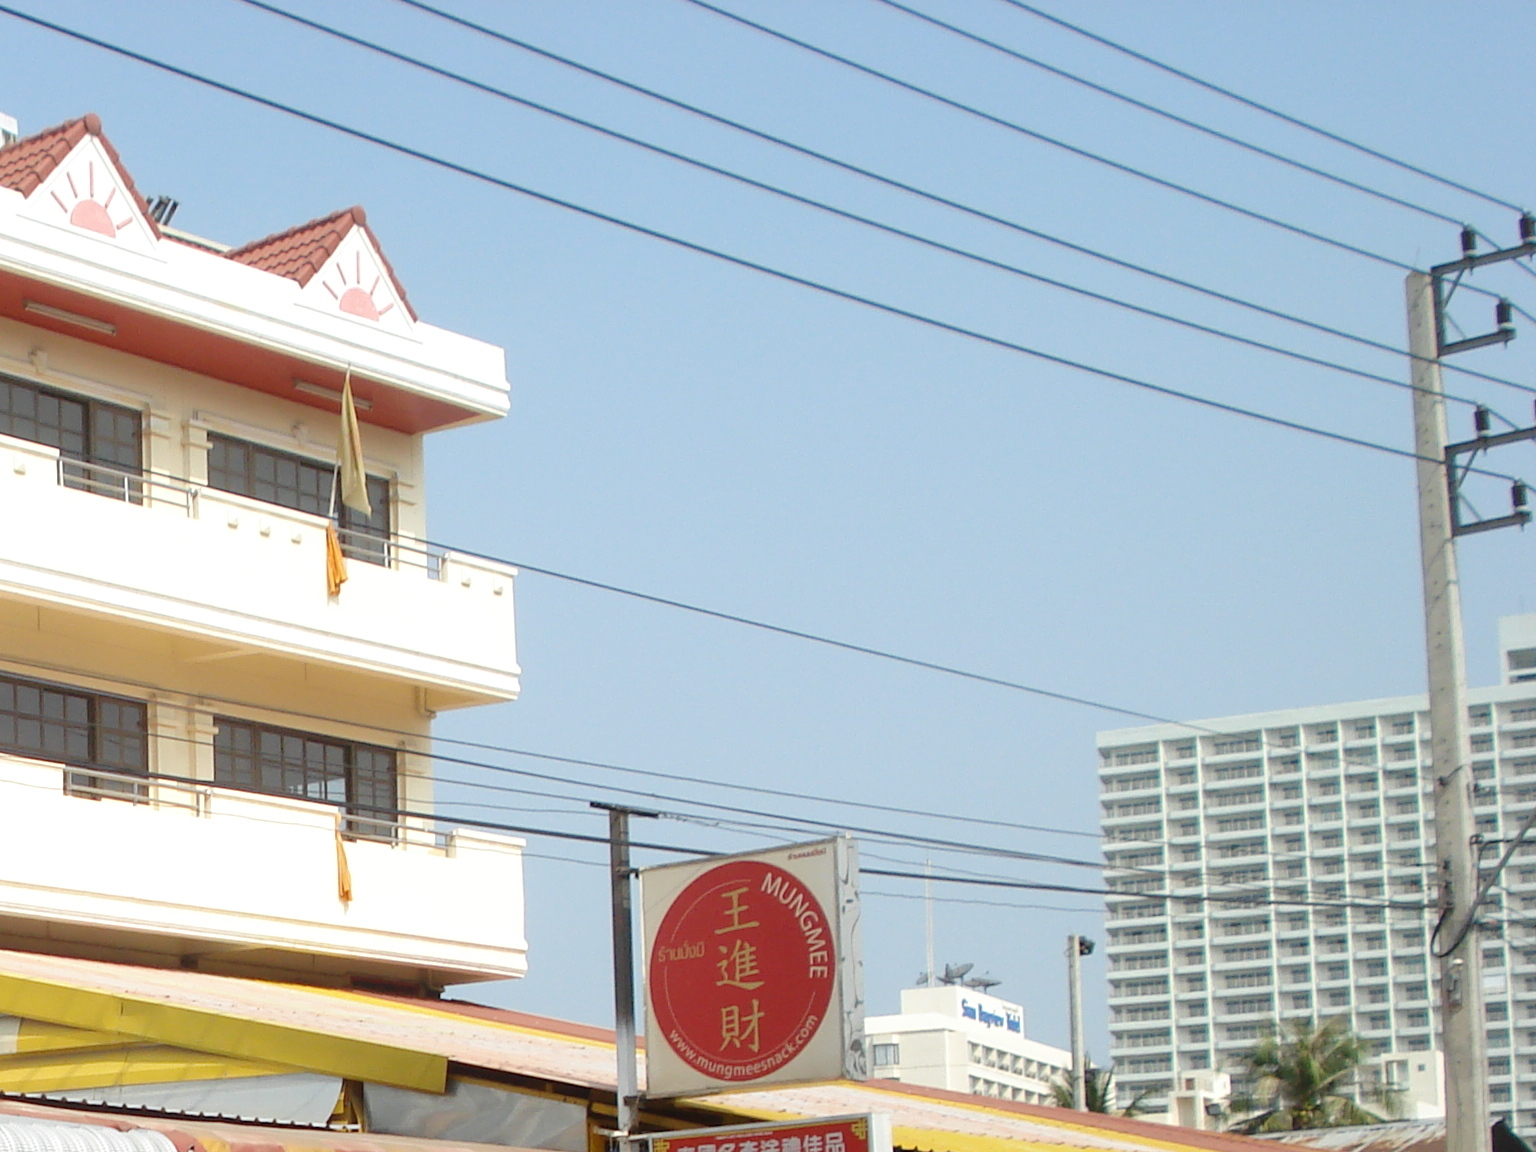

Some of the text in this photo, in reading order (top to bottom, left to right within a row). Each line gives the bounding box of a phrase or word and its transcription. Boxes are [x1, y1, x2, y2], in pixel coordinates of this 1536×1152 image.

[713, 886, 766, 1054] 王進財
[760, 871, 830, 980] MUNGMEE
[669, 1013, 819, 1080] www.mungmeesnack.com
